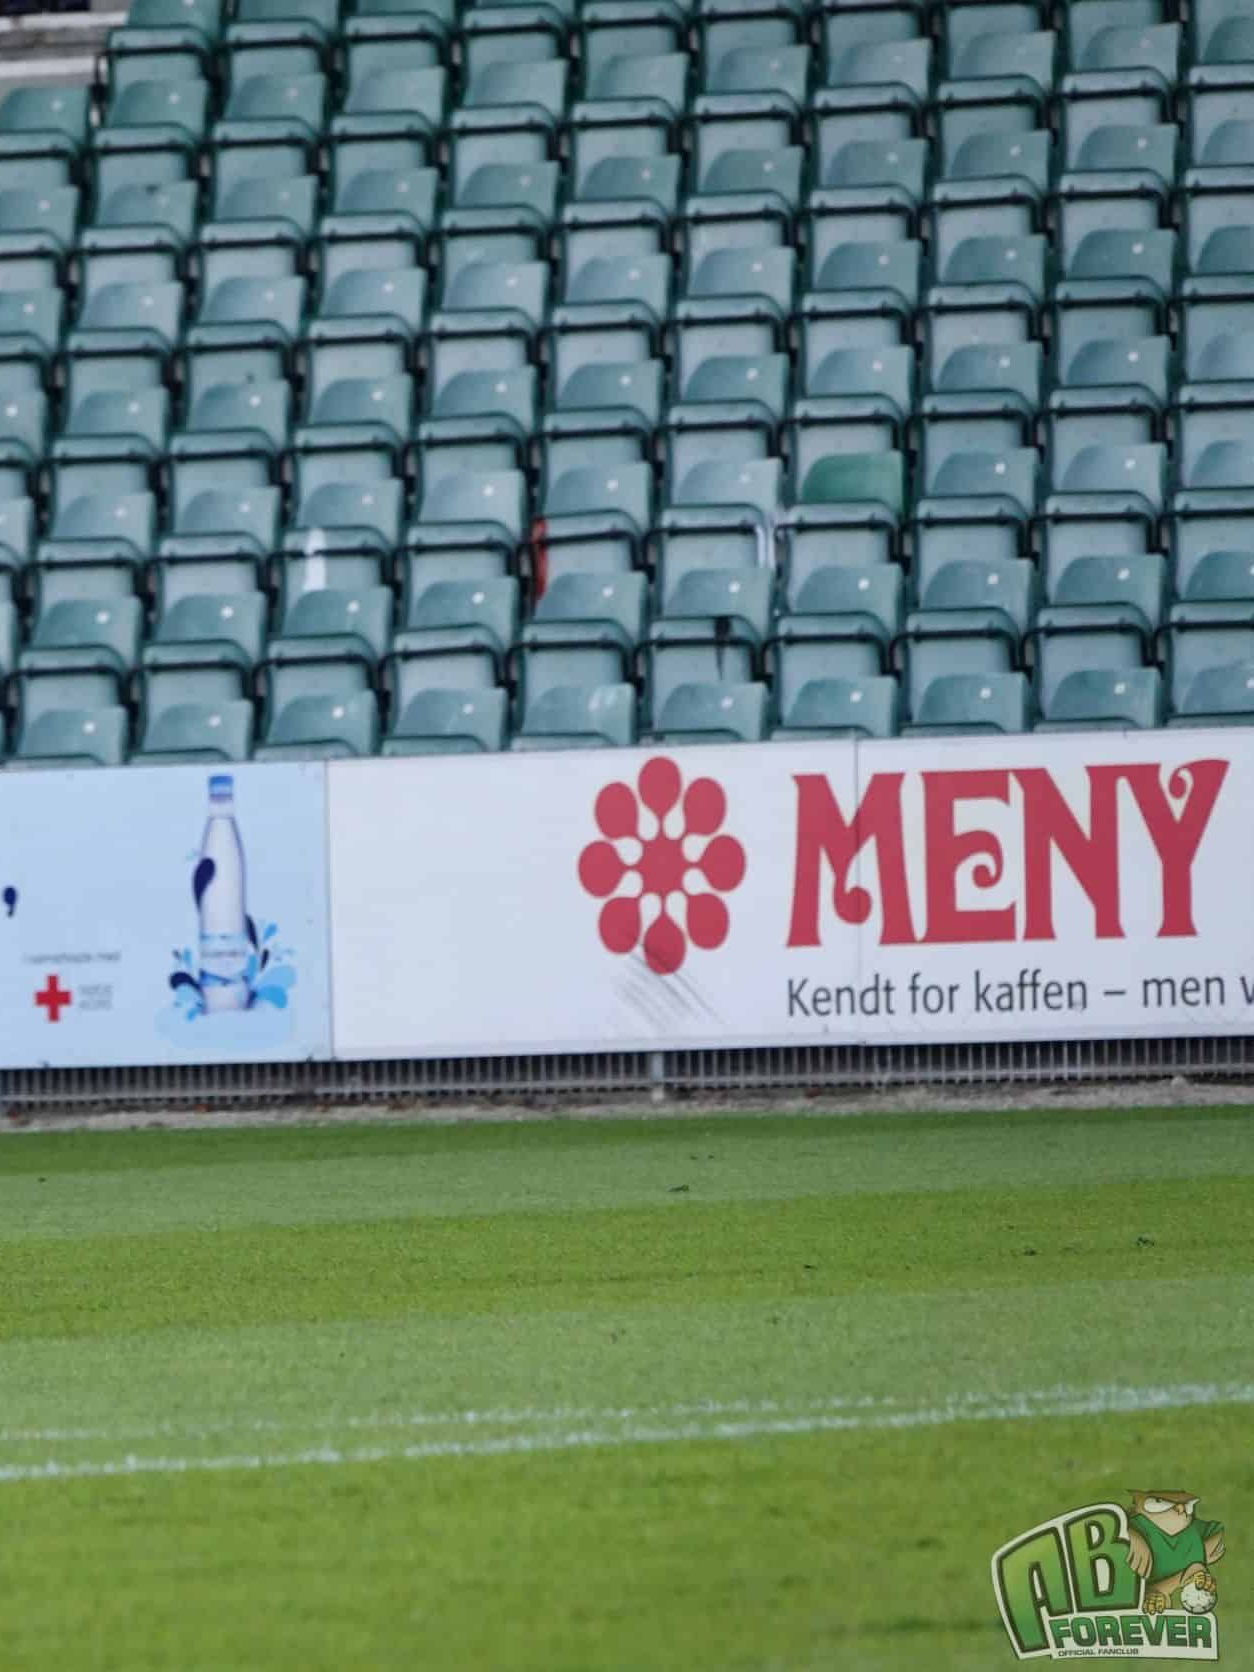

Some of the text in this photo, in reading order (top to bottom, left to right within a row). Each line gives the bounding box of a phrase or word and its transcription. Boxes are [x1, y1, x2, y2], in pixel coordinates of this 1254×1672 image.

[786, 759, 1230, 947] MENY
[787, 974, 896, 1016] Kendt
[908, 972, 960, 1014] for
[973, 969, 1088, 1011] kaffen
[1142, 975, 1225, 1008] men
